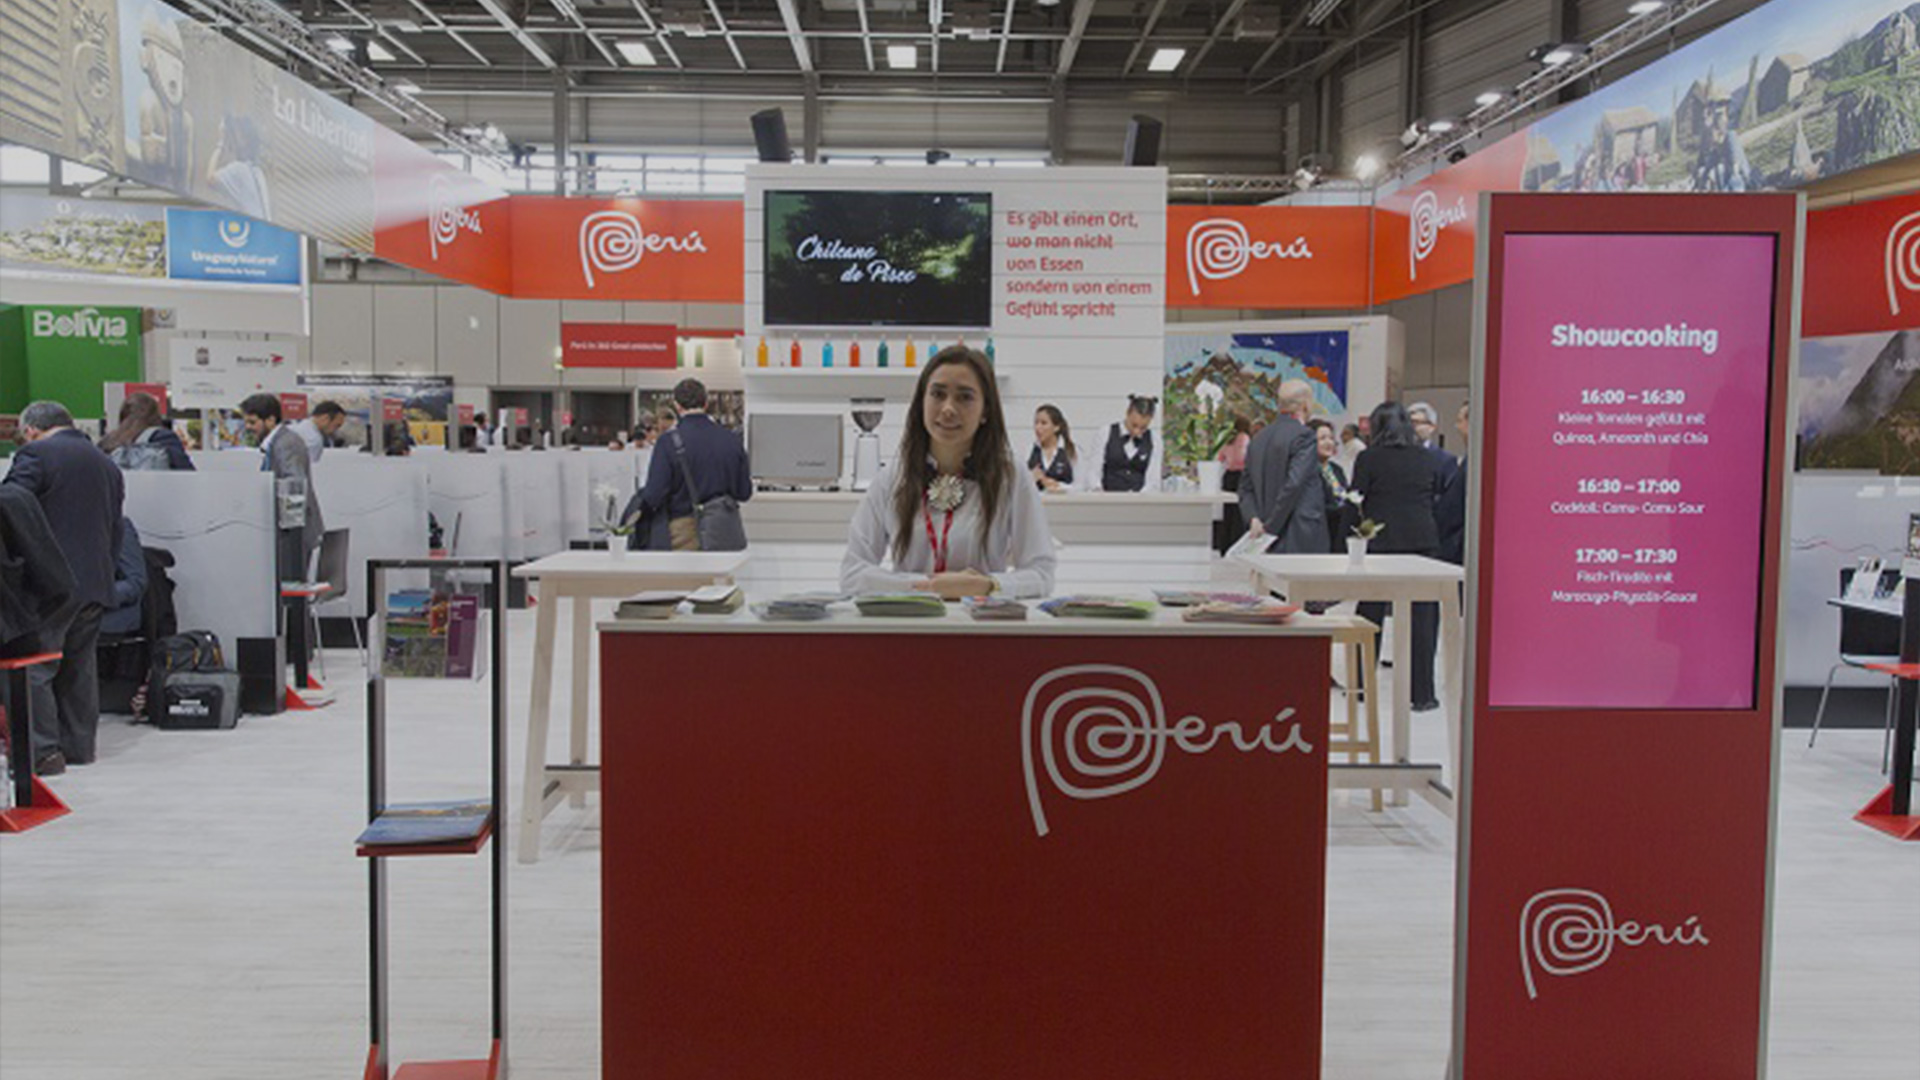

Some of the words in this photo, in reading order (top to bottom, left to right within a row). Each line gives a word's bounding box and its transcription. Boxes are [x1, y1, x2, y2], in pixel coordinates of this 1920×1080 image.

[1006, 210, 1025, 226] Es
[1028, 210, 1059, 230] gibt
[1063, 211, 1105, 227] einen
[1108, 211, 1138, 228] Ort,
[579, 211, 707, 288] Perú
[1006, 236, 1032, 249] wo
[1035, 236, 1071, 249] man
[1073, 234, 1113, 249] nicht
[1006, 258, 1037, 271] von
[1040, 256, 1084, 271] Essen
[1186, 218, 1313, 296] Perú
[840, 263, 864, 282] de
[866, 259, 917, 283] Pisco
[1006, 279, 1068, 294] sondern
[1072, 281, 1103, 294] von
[1106, 279, 1152, 295] einem
[1006, 301, 1058, 319] Gefühl
[1061, 301, 1115, 319] spricht
[33, 308, 127, 338] Bolivia
[1551, 322, 1718, 354] Showcooking
[1581, 389, 1625, 404] 16:00
[1641, 389, 1685, 404] 16:30
[1558, 412, 1594, 425] Kleine
[1595, 412, 1643, 425] Tomaten
[1686, 412, 1705, 425] mit
[1600, 431, 1656, 444] Amaranth
[1659, 432, 1682, 444] und
[1683, 431, 1709, 444] Chia
[1577, 478, 1621, 493] 16:30
[1637, 479, 1681, 493] 17:00
[1678, 501, 1705, 514] Sour
[1575, 548, 1619, 563] 17:00
[1634, 548, 1677, 563] 17:30
[1021, 663, 1314, 837] Perú
[1519, 887, 1710, 1000] Perú
